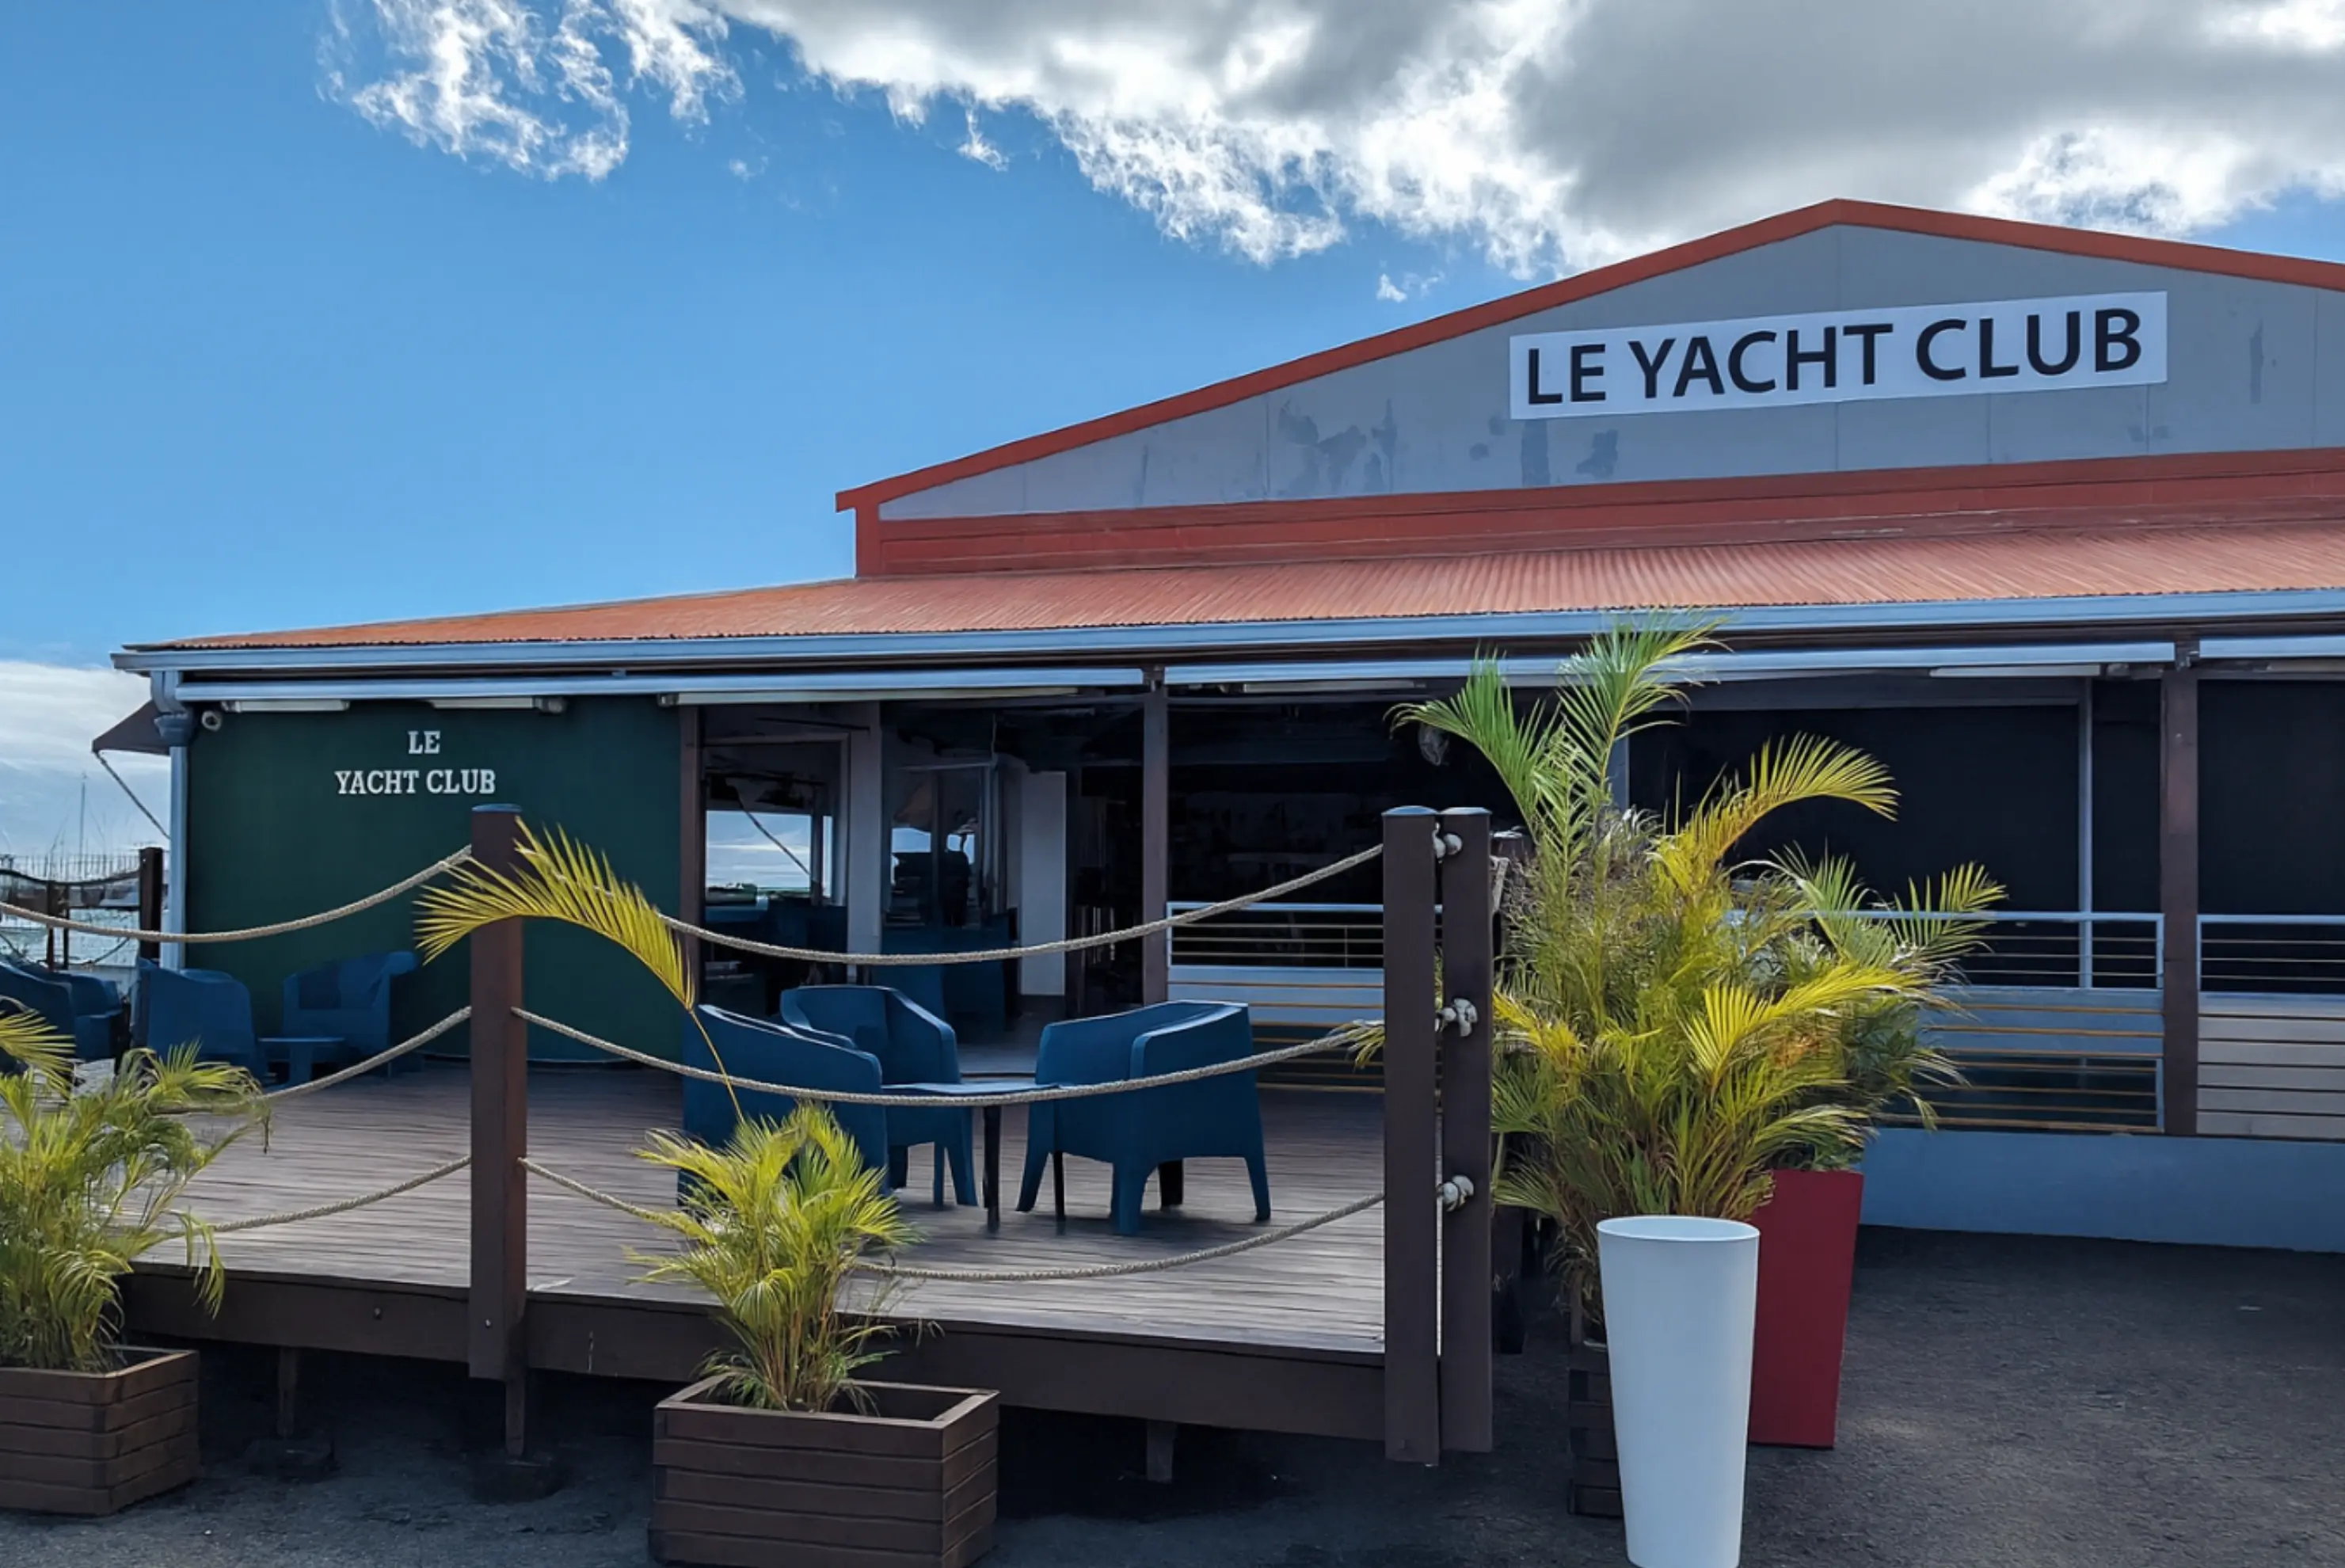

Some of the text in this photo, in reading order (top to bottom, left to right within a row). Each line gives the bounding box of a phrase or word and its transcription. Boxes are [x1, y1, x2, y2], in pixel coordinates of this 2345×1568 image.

[1527, 307, 2142, 405] LE YACHT CLUB
[407, 730, 441, 754] LE
[334, 768, 497, 794] YACHT CLUB
